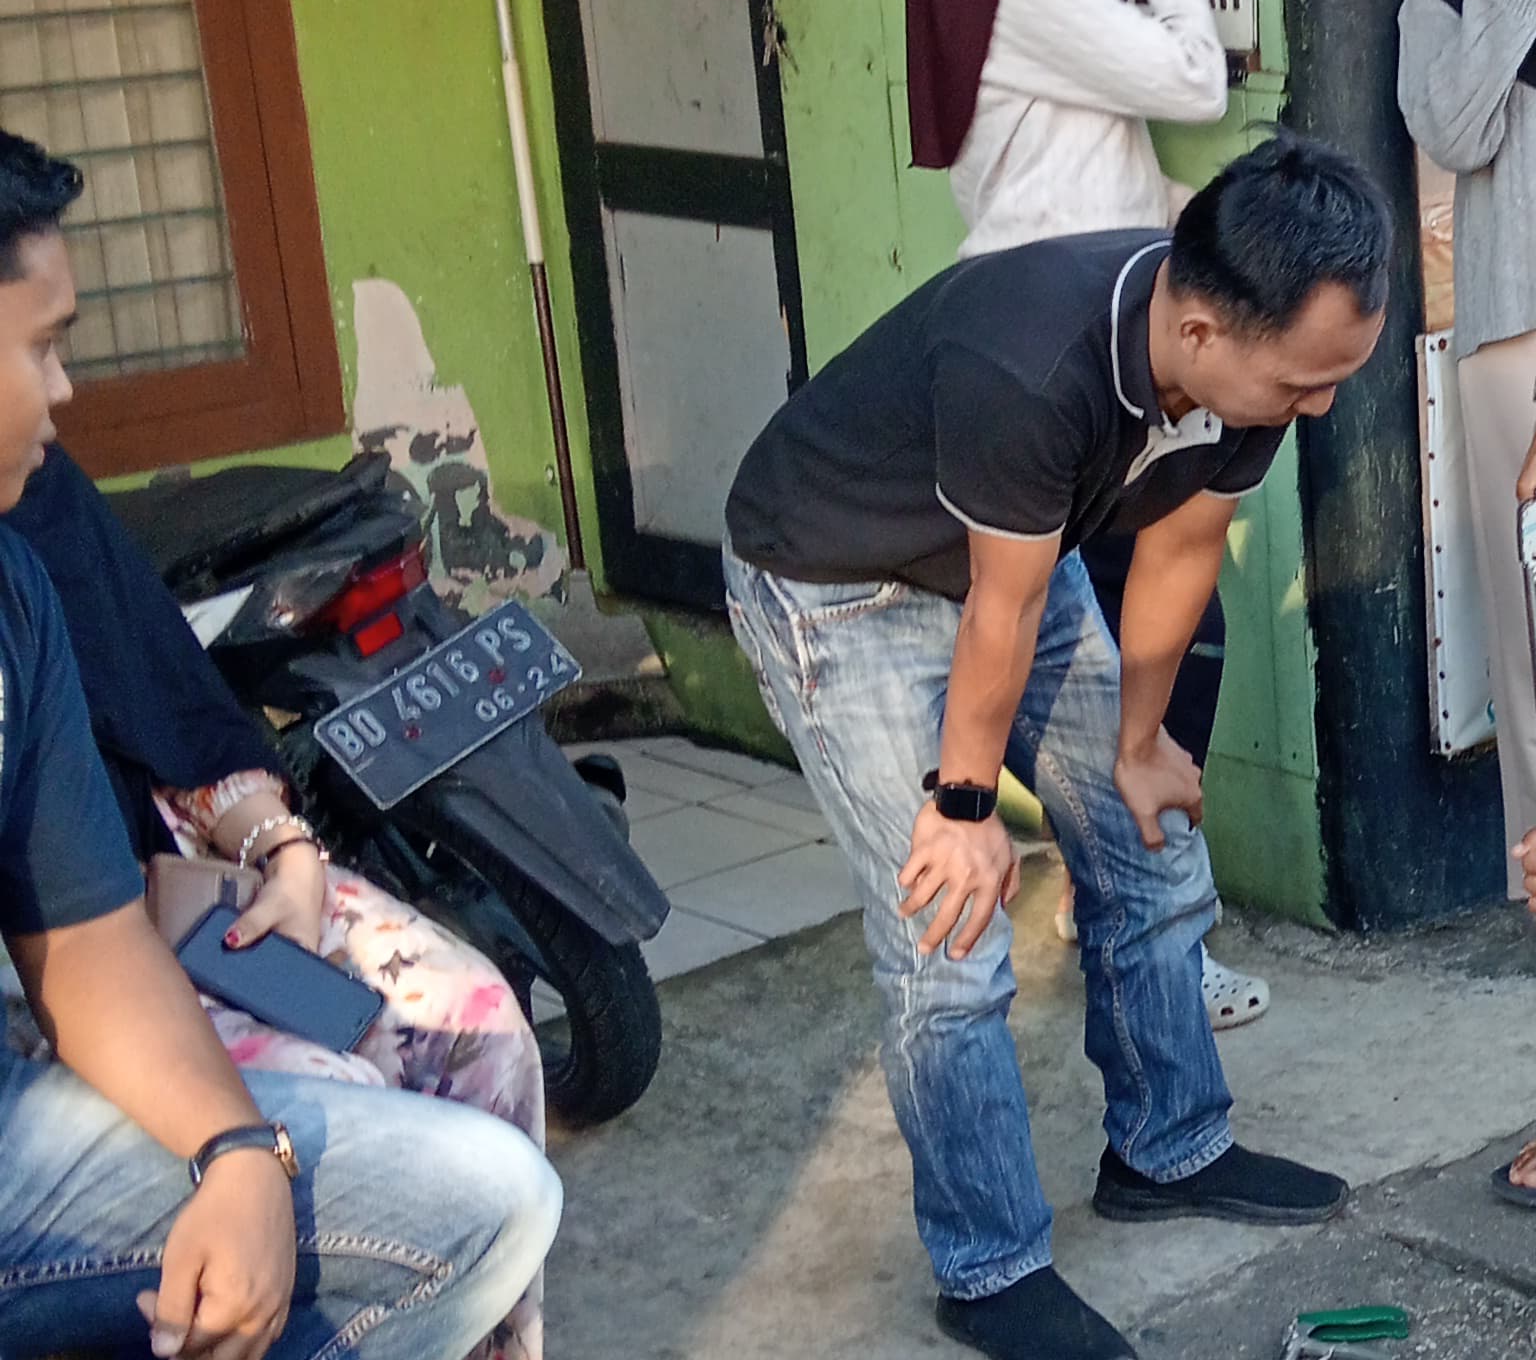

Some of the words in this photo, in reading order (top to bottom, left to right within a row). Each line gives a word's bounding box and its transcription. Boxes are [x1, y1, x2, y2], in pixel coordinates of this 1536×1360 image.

[327, 708, 387, 760] BD
[391, 649, 480, 721] 4616
[474, 616, 532, 665] PS
